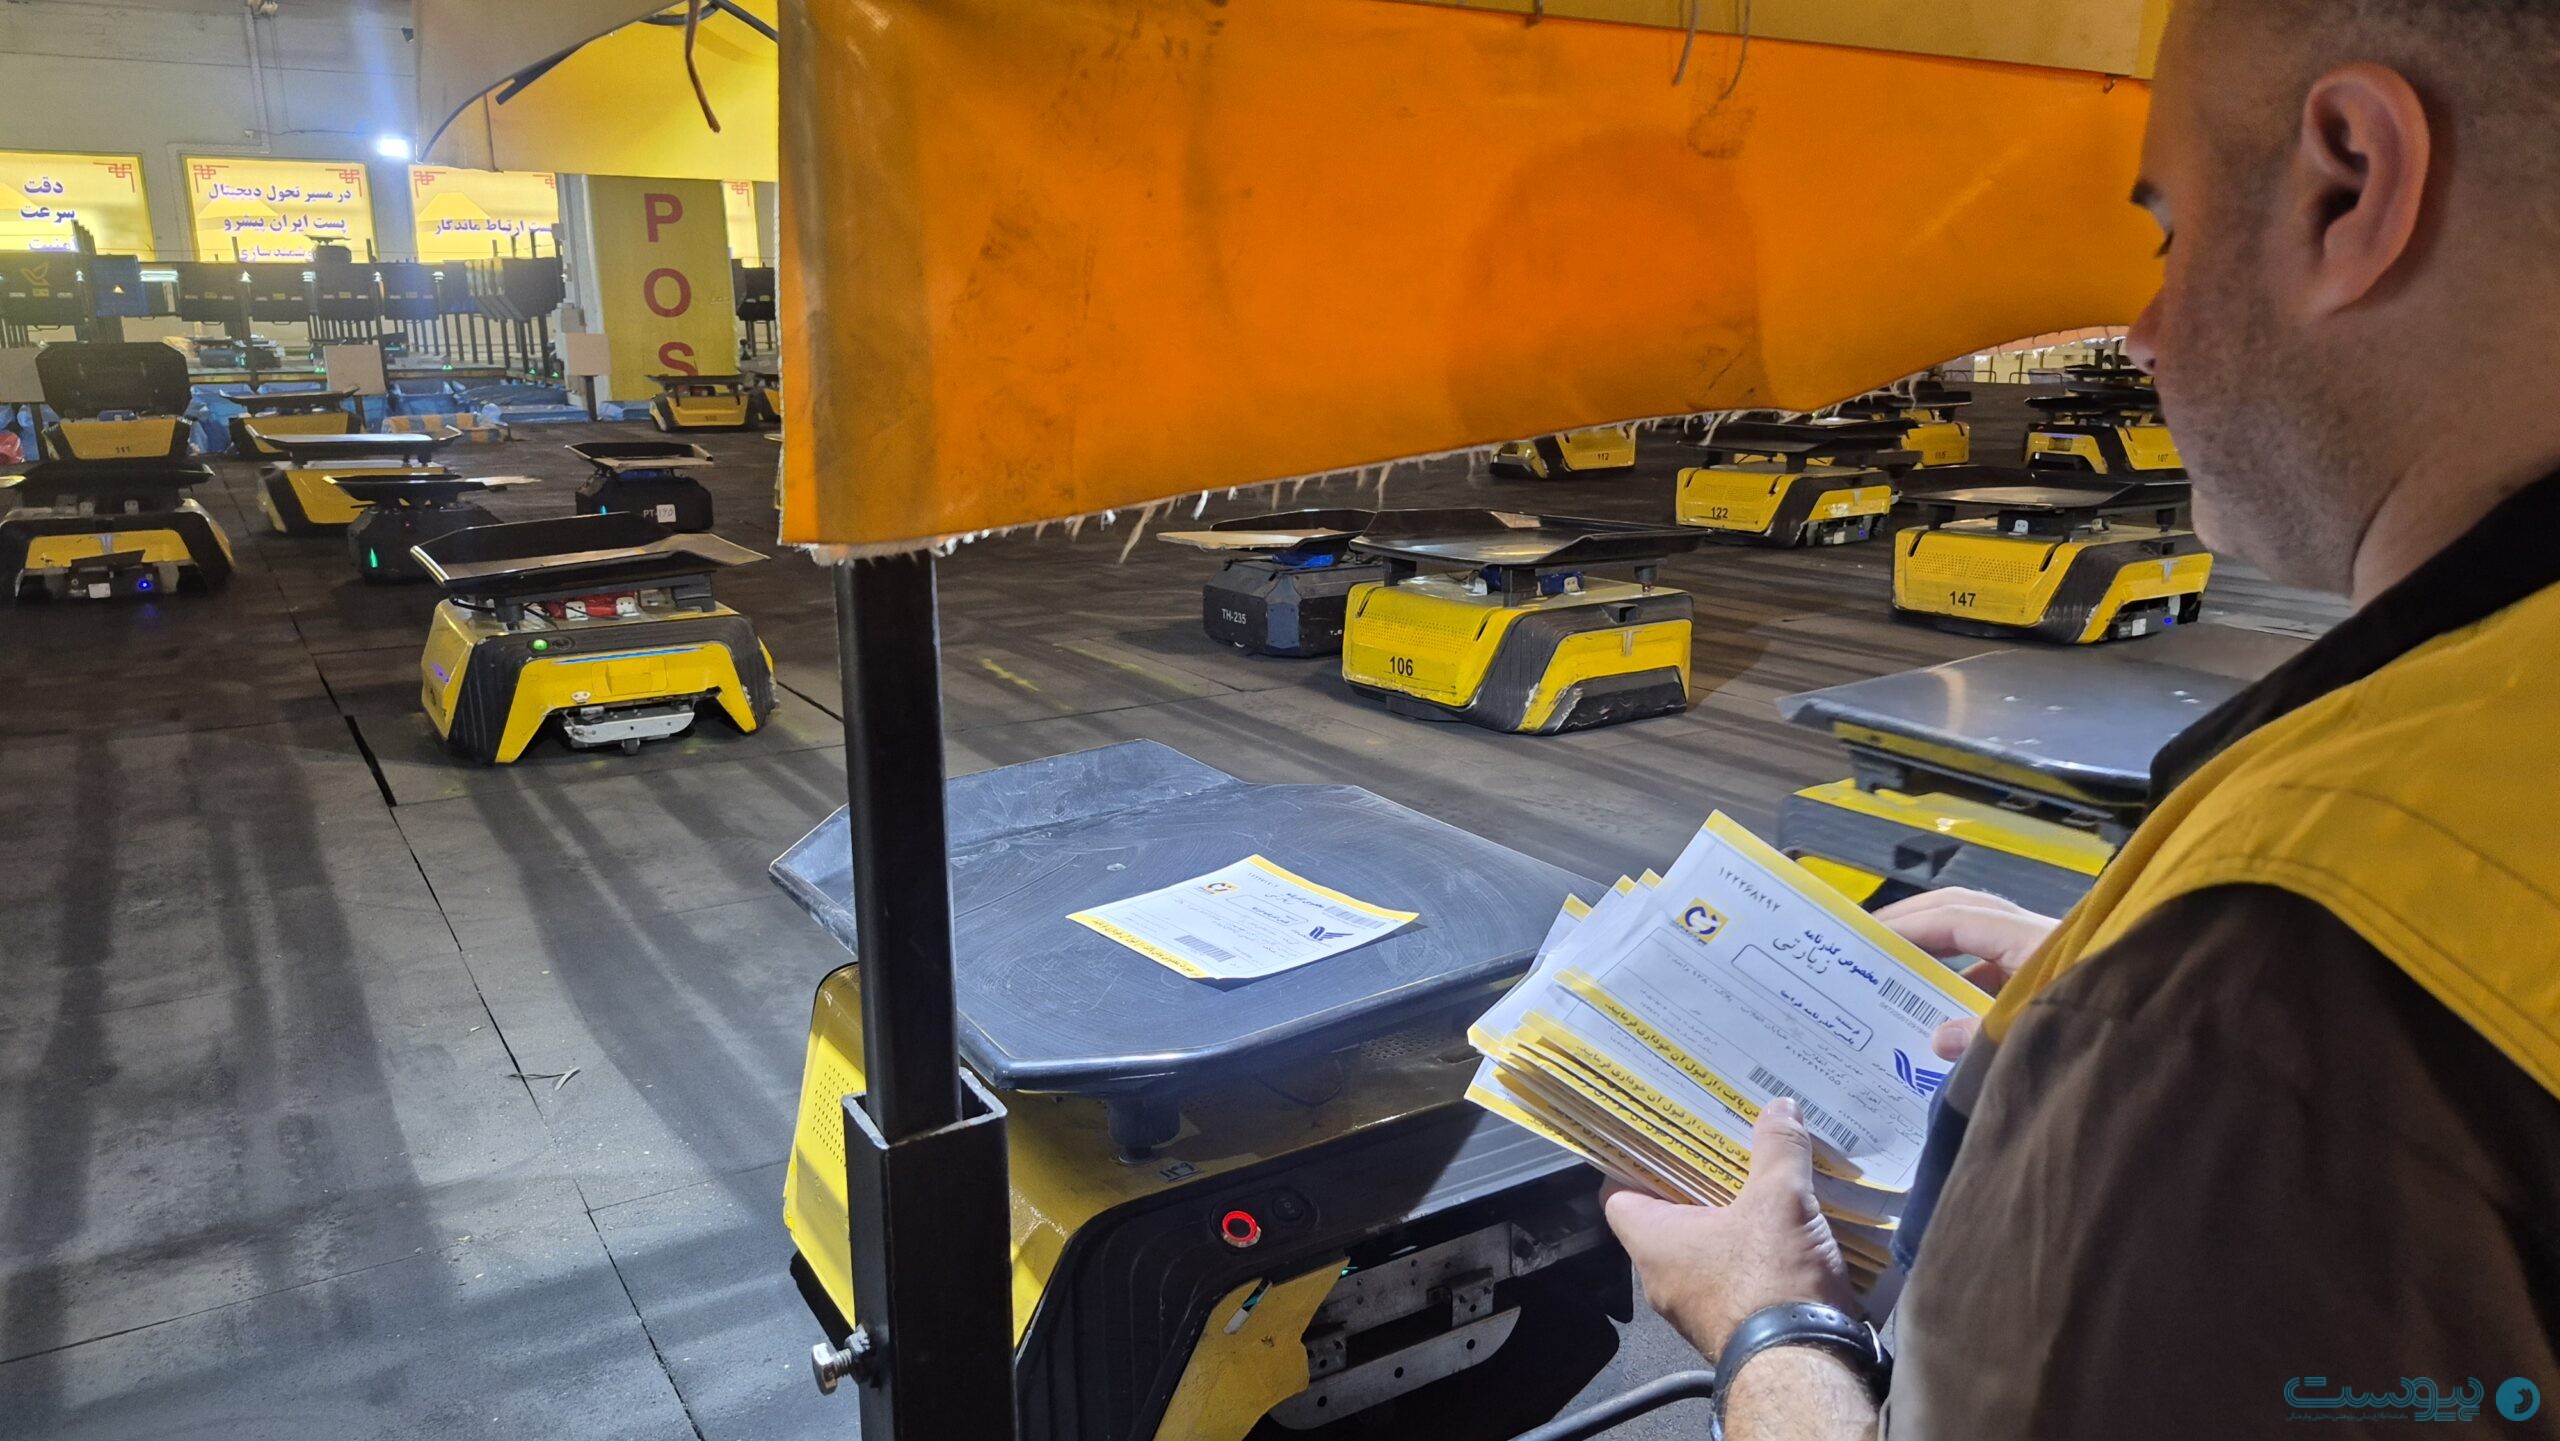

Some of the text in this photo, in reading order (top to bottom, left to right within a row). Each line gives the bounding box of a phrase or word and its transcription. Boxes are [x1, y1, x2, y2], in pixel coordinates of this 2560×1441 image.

[24, 176, 64, 193] دقت
[337, 190, 351, 203] در
[224, 214, 346, 233] پست ایران پیشرو
[486, 219, 524, 237] ارتباط
[1597, 453, 1609, 461] 112
[1711, 507, 1728, 519] 122
[1949, 591, 1976, 607] 147
[1222, 608, 1247, 625] TH-235
[1389, 655, 1414, 676] 106
[1772, 938, 1830, 975] زیارتی
[1804, 930, 1879, 986] مخصوص گذرنامه
[1670, 1053, 1687, 1064] آن
[1684, 1063, 1708, 1079] قبول
[1705, 1079, 1718, 1088] از
[1646, 1093, 1663, 1104] آن
[1722, 1090, 1745, 1109] پاکت
[1662, 1103, 1685, 1119] قبول
[1702, 1129, 1726, 1148] پاکت
